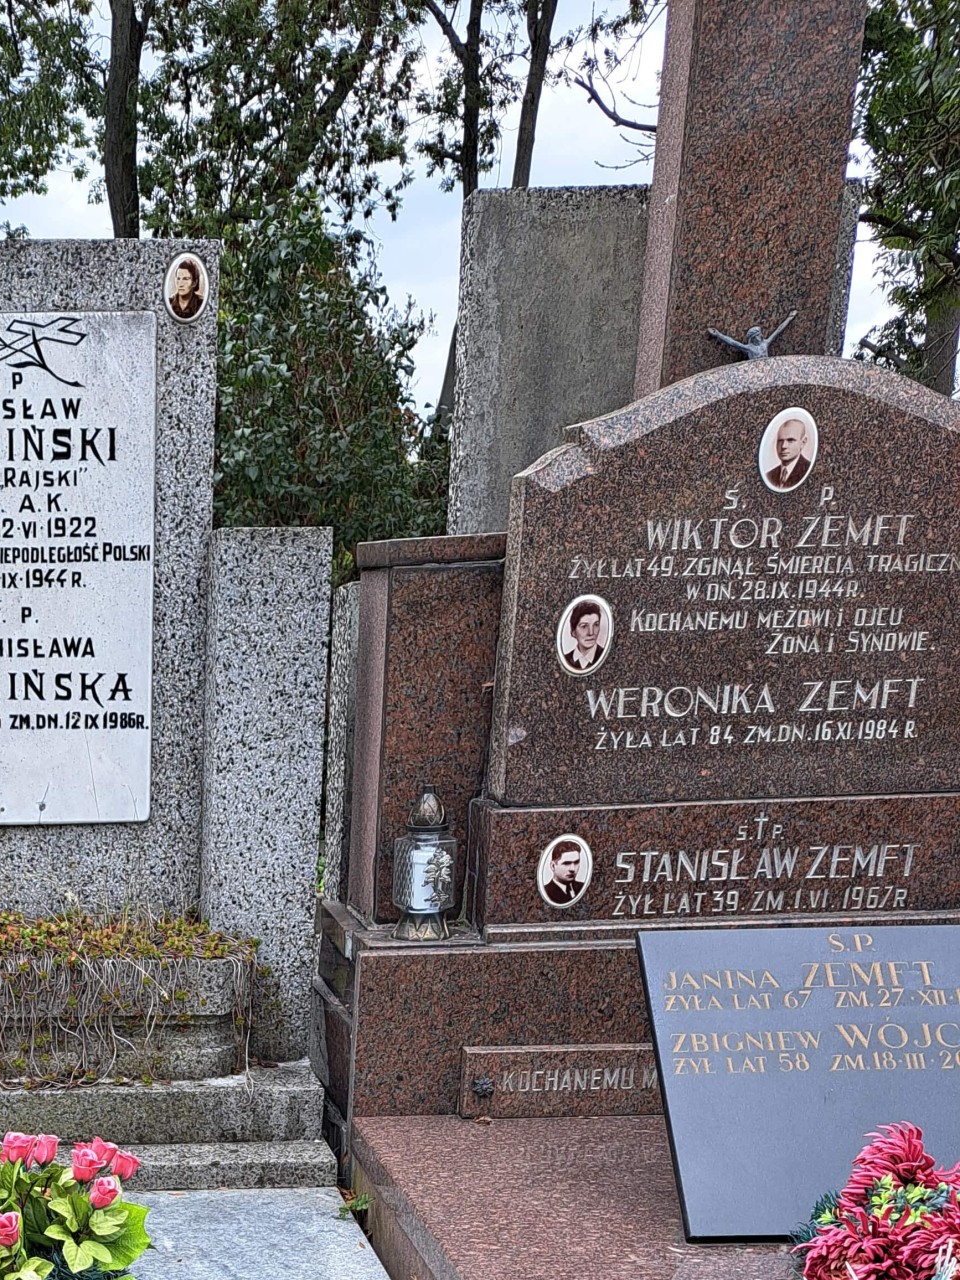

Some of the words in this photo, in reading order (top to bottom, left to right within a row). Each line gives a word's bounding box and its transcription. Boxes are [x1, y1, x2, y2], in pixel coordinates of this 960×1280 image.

[646, 517, 784, 551] WIKTOR
[795, 514, 915, 548] ZEMFT
[102, 543, 151, 562] POLSKI
[630, 608, 748, 633] KOCHANEMU
[854, 607, 904, 626] OJCU
[765, 630, 820, 655] ŻONA
[586, 682, 776, 720] WERONIKA
[798, 676, 925, 713] ZEMFT
[594, 726, 652, 750] ŻYŁA
[661, 727, 700, 748] LAT
[709, 725, 734, 745] 84
[615, 846, 800, 883] STANISŁAW
[806, 843, 919, 879] ZEMFT
[663, 892, 707, 914] LAT
[663, 970, 780, 991] JANINA
[801, 961, 936, 988] ZEMFT
[664, 994, 724, 1012] ŻYŁA
[732, 991, 773, 1010] LAT
[784, 990, 812, 1009] 67
[670, 1031, 822, 1053] ZBIGNIEW
[673, 1056, 716, 1075] ŻYŁ
[727, 1055, 767, 1073] LAT
[779, 1052, 810, 1073] 58
[502, 1067, 634, 1092] KOCHANEMU
